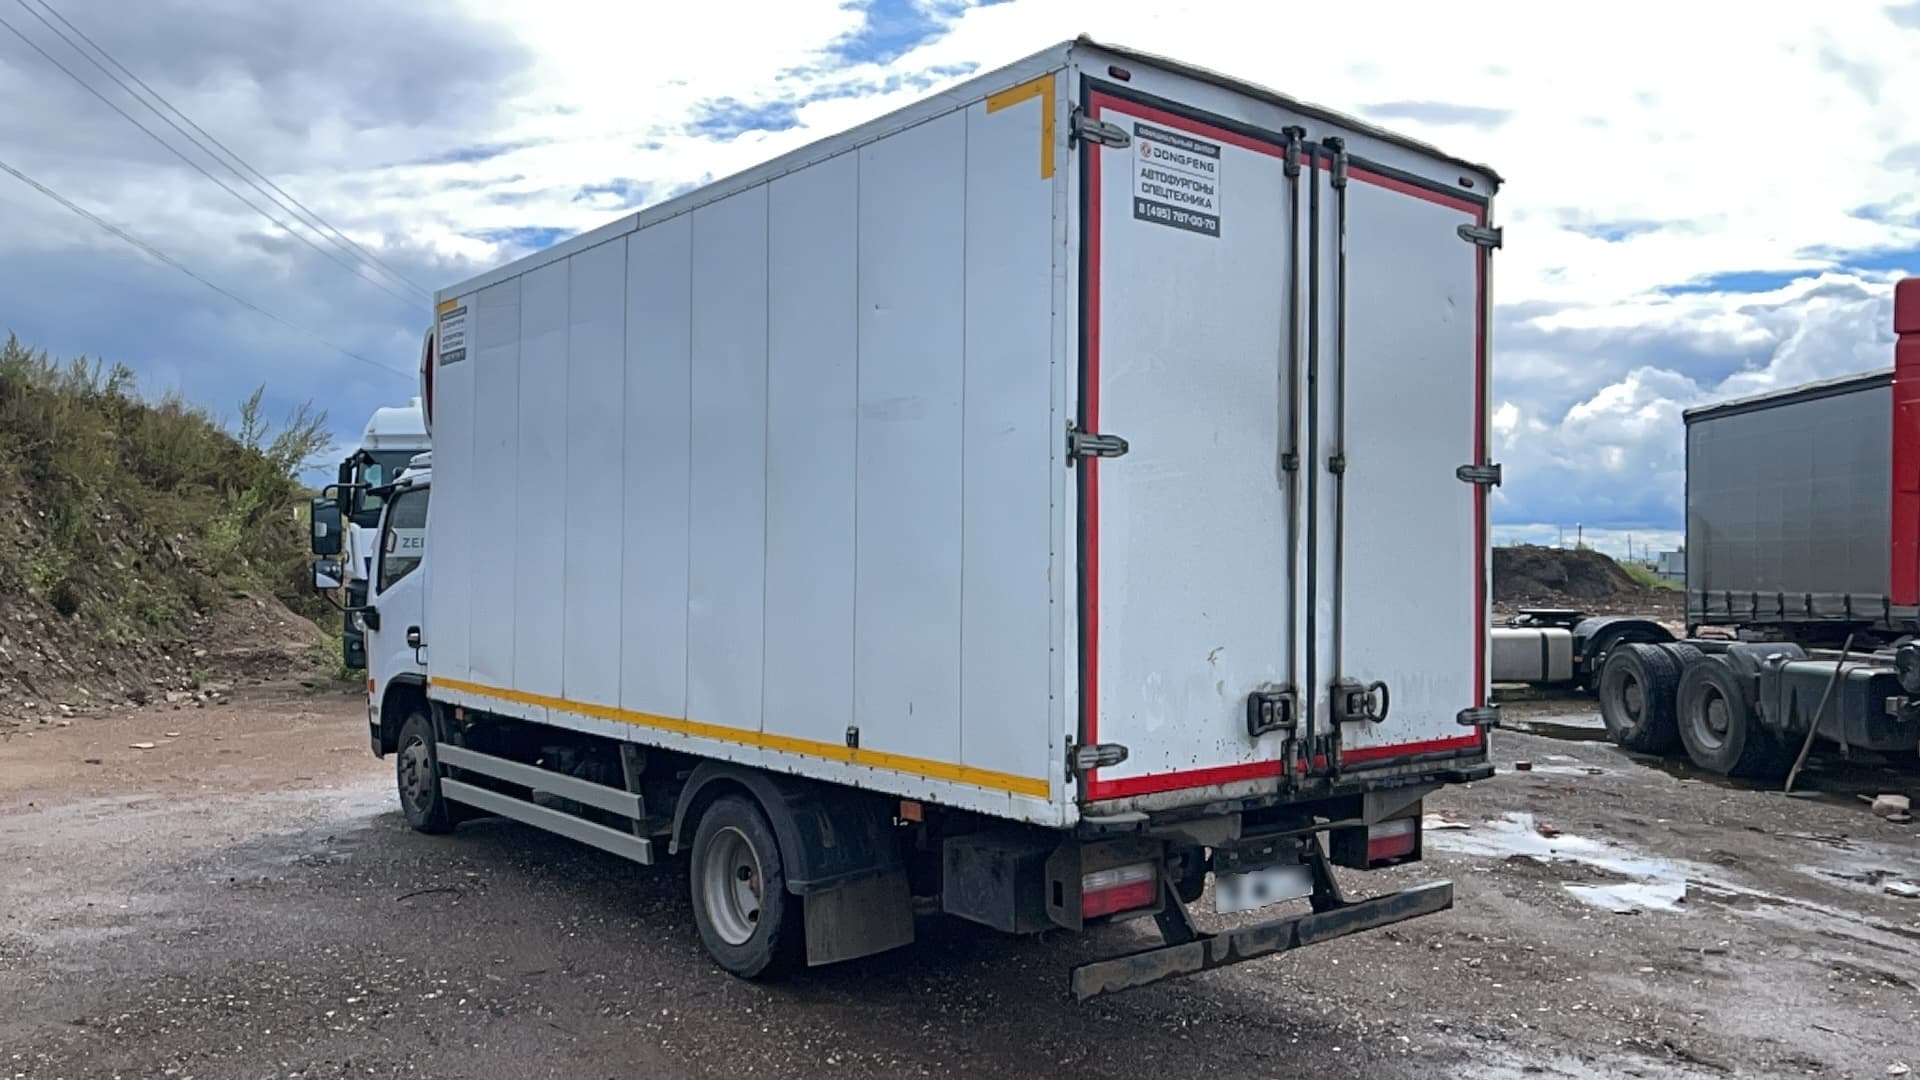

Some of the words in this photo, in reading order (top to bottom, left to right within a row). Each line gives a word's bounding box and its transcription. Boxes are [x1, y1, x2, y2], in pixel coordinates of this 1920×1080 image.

[1154, 147, 1214, 173] DONGFENG
[1140, 168, 1214, 195] АВТОФУРГОНЫ
[1141, 182, 1212, 209] СПЕЦТЕХНИКА
